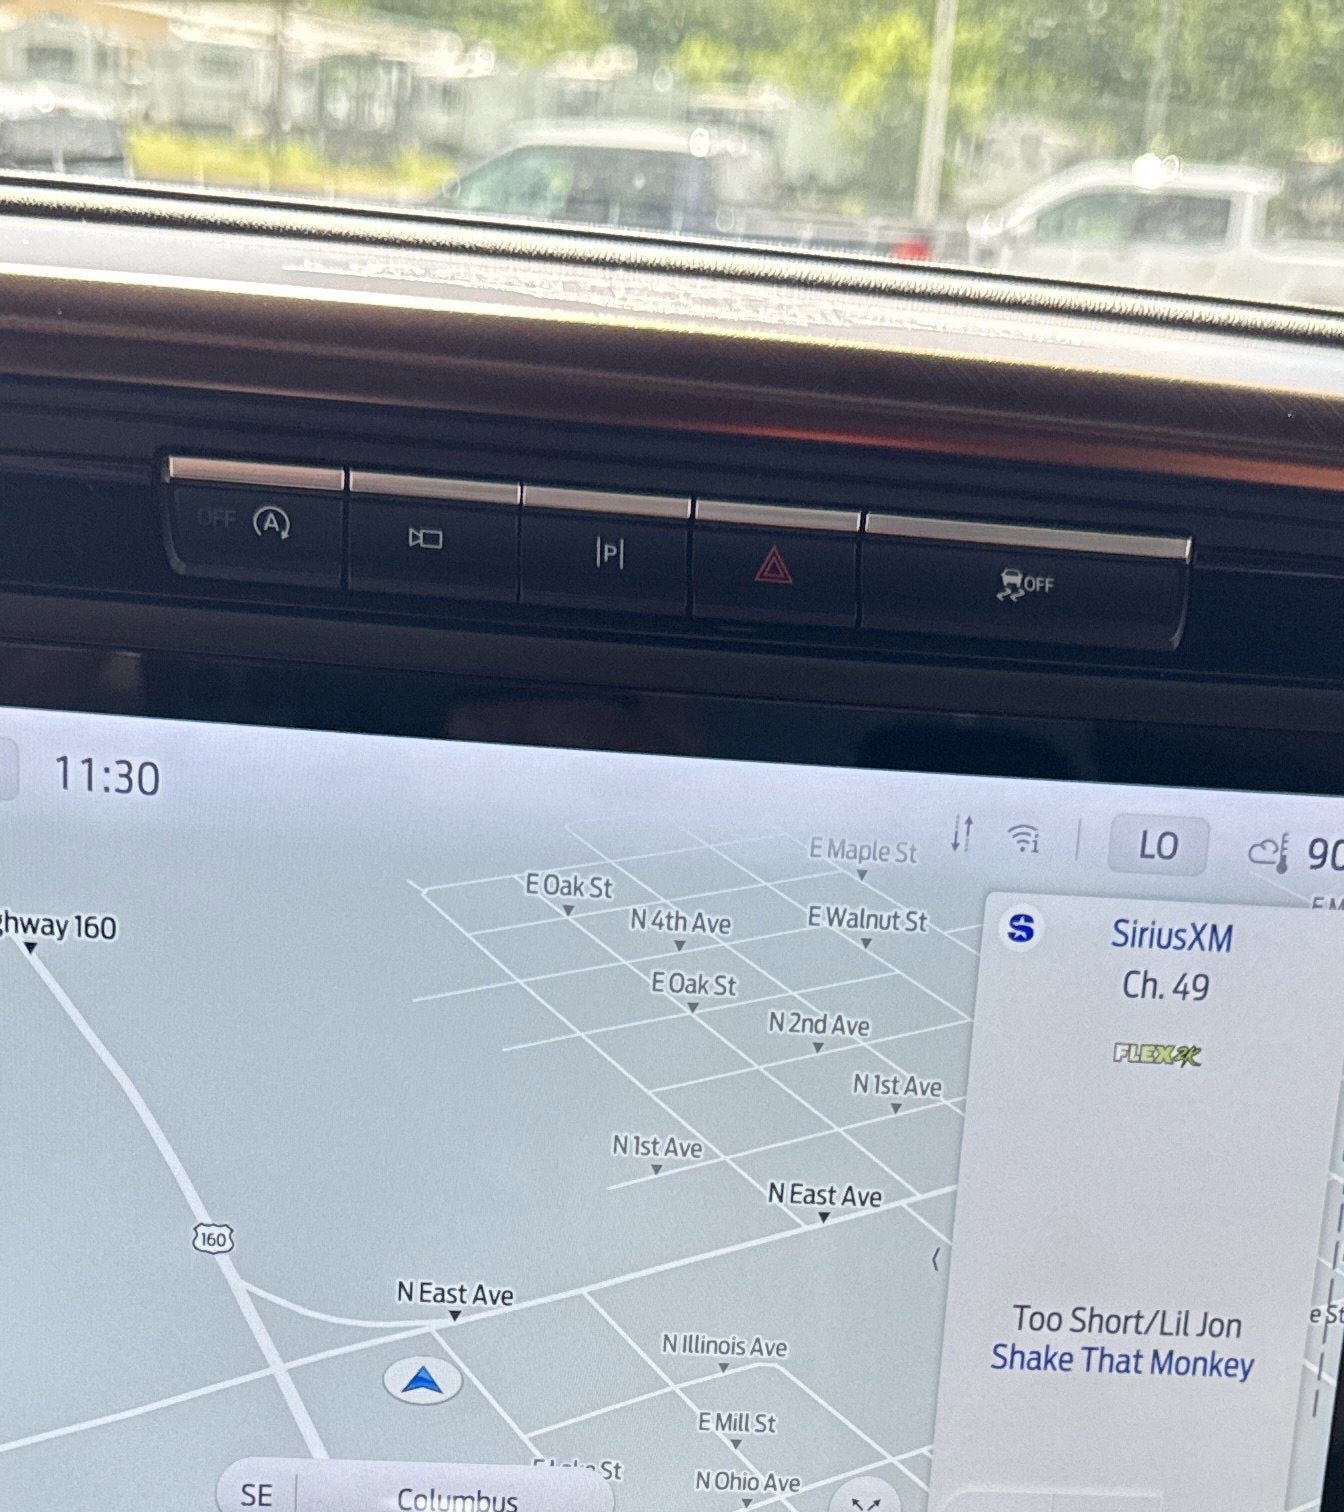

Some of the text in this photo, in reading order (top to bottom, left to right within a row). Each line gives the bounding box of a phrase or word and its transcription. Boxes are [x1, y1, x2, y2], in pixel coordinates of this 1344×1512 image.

[1023, 575, 1055, 594] OFF
[55, 754, 161, 797] 11:30
[809, 836, 918, 868] E Maple St
[1139, 829, 1180, 861] LO
[526, 872, 613, 901] E Oak St
[74, 914, 118, 940] 160
[631, 907, 732, 936] N 4th Ave
[808, 905, 929, 934] E Walnut St
[1111, 918, 1235, 954] SiriusXM
[651, 971, 737, 998] E Oak St
[1122, 969, 1211, 1002] Ch. 49
[769, 1011, 871, 1038] N 2nd Ave
[853, 1073, 943, 1099] N 1st Ave
[613, 1135, 703, 1160] N 1st Ave
[769, 1182, 883, 1209] N East Ave
[200, 1231, 228, 1249] 160
[397, 1280, 514, 1307] N East Ave
[1013, 1304, 1243, 1339] Too Short/Lil Jon
[662, 1333, 788, 1358] N Illinois Ave
[991, 1343, 1256, 1384] Shake That Monkey
[698, 1412, 777, 1435] E Mill St
[240, 1482, 274, 1508] SE
[696, 1471, 802, 1494] N Ohio Ave
